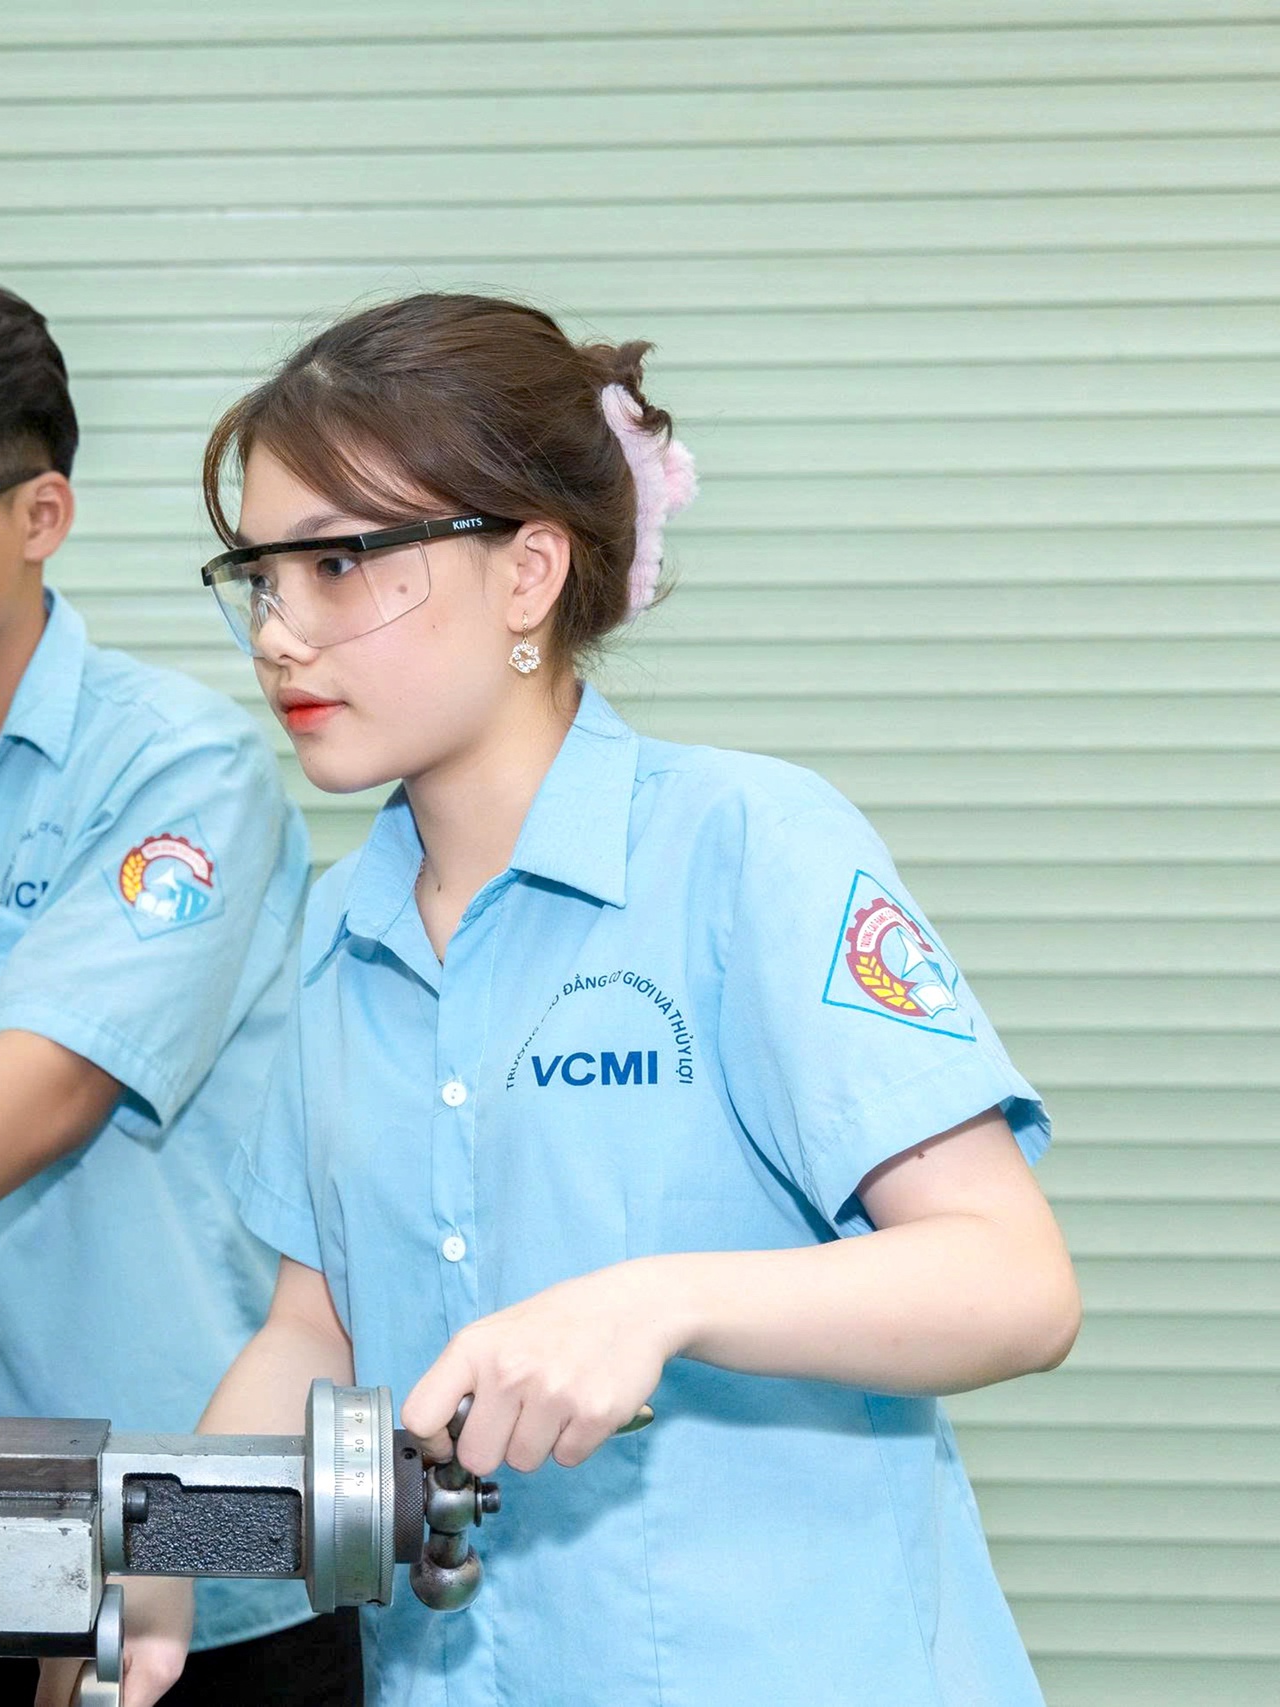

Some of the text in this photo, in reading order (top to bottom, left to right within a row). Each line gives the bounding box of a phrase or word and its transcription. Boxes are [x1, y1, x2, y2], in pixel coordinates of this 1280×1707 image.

[452, 517, 483, 531] KINTS
[563, 973, 608, 996] ĐẲNG
[622, 971, 657, 998] GIỚI
[654, 991, 674, 1015] VÀ
[668, 1009, 694, 1055] THỦY
[531, 1050, 659, 1088] VCMI
[676, 1058, 694, 1084] LỢI
